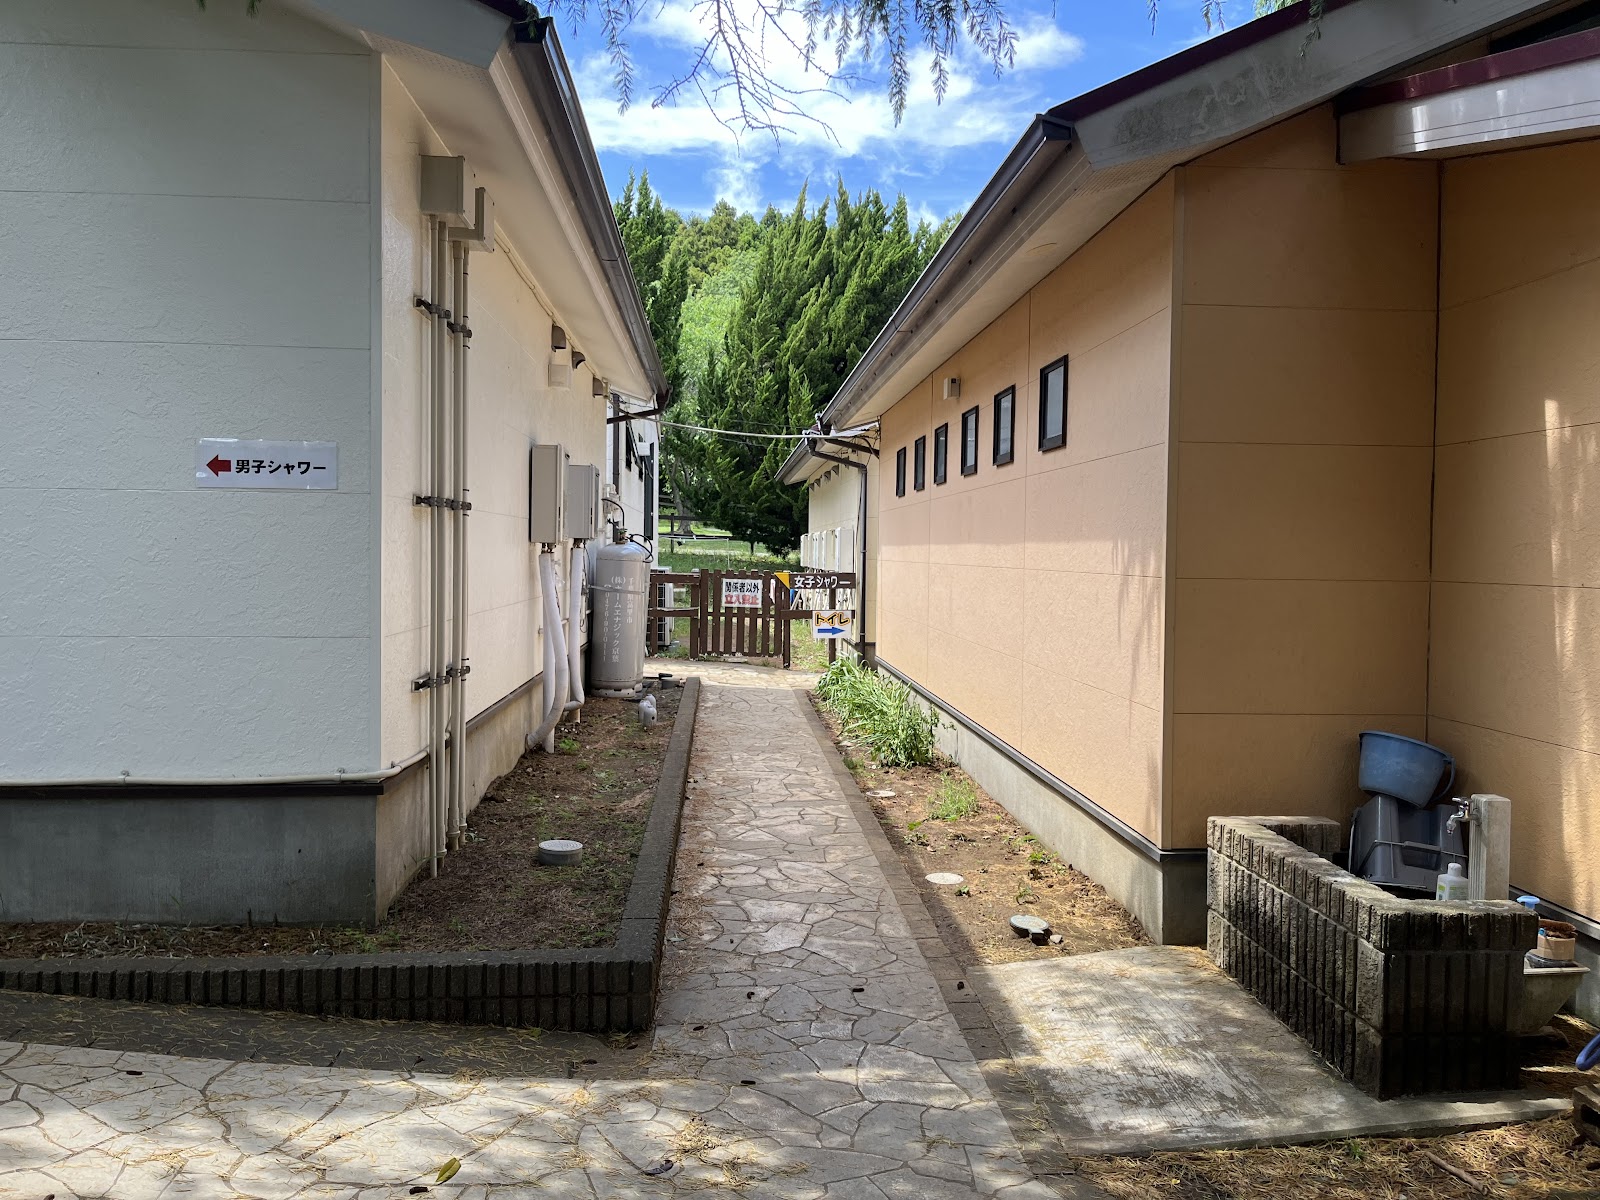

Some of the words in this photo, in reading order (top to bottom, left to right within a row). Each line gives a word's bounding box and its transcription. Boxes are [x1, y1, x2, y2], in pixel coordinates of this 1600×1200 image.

[235, 459, 327, 475] 男子シャワー
[725, 581, 760, 594] 関係者以外
[794, 575, 851, 588] 女子シャワー
[725, 594, 759, 605] 立入禁止
[815, 612, 850, 626] トイレ
